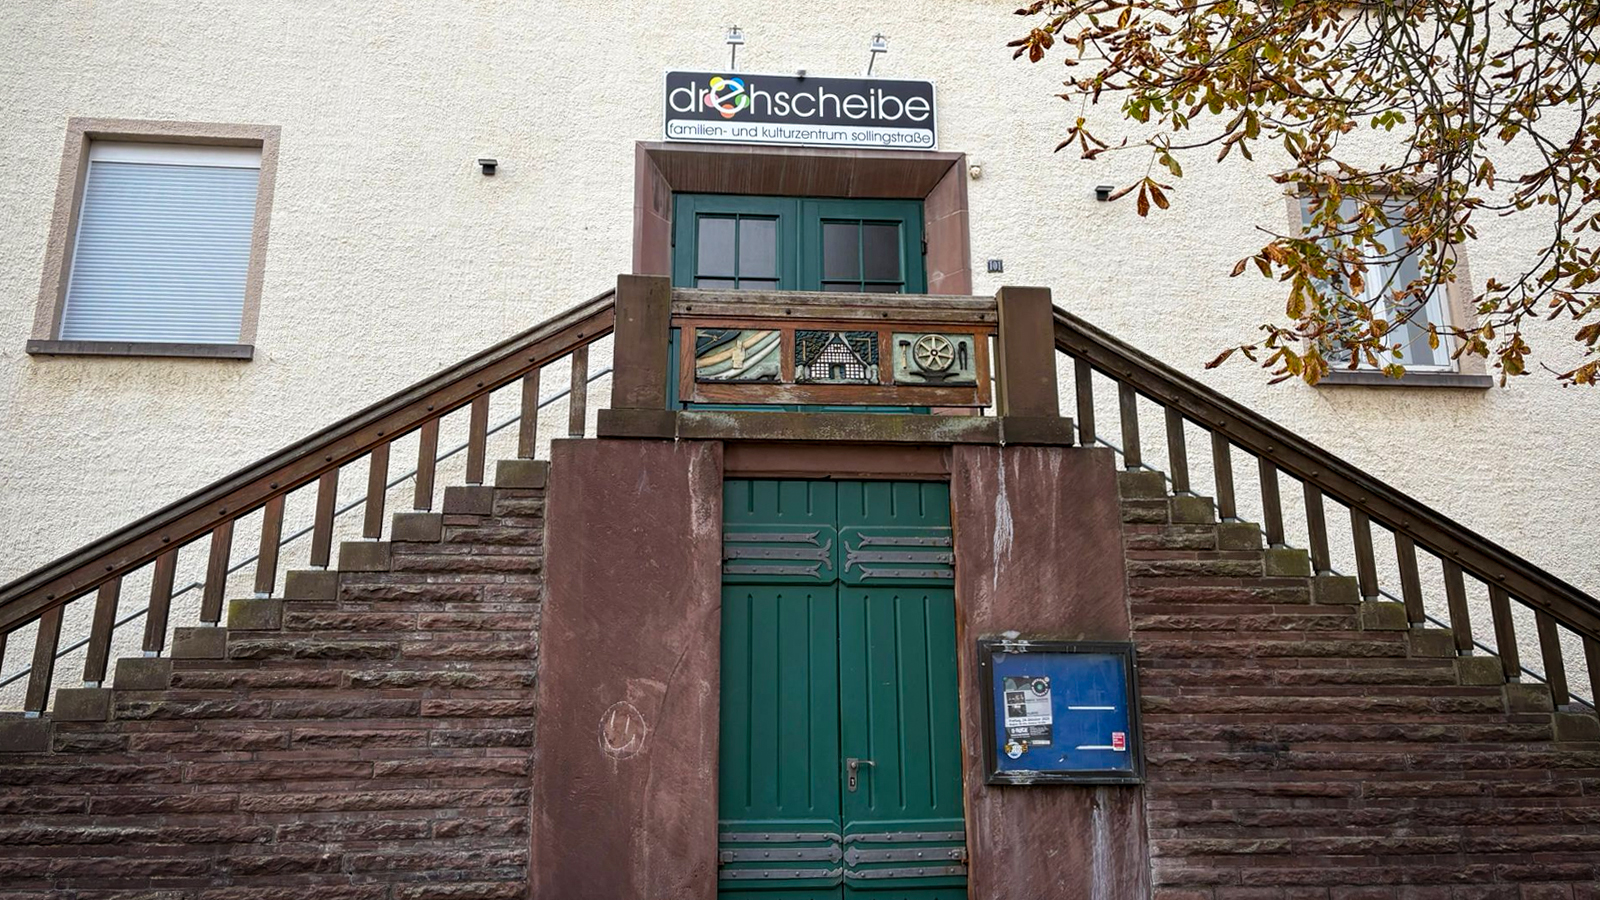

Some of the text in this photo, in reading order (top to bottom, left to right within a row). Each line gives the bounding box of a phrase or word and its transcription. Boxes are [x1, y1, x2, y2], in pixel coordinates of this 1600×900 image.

[669, 80, 931, 121] drehscheibe
[669, 123, 931, 145] familien- und kulturzentrum sollingstraße
[989, 260, 1001, 271] 101
